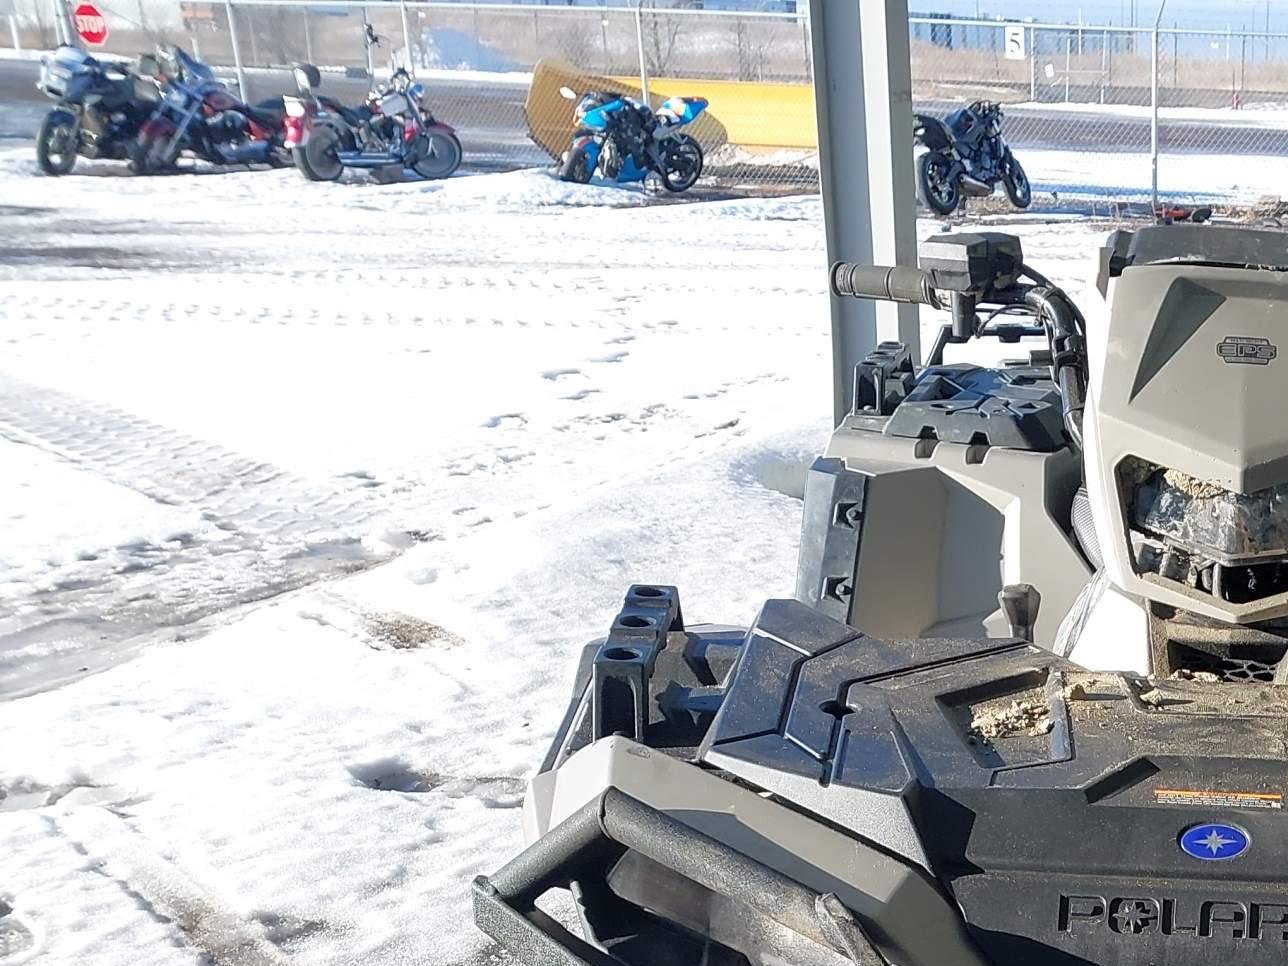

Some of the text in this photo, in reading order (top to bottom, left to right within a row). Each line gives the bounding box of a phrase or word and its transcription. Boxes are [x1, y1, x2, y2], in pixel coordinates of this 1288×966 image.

[76, 15, 104, 33] STOP
[1010, 32, 1021, 53] 5
[1217, 343, 1277, 359] EPS
